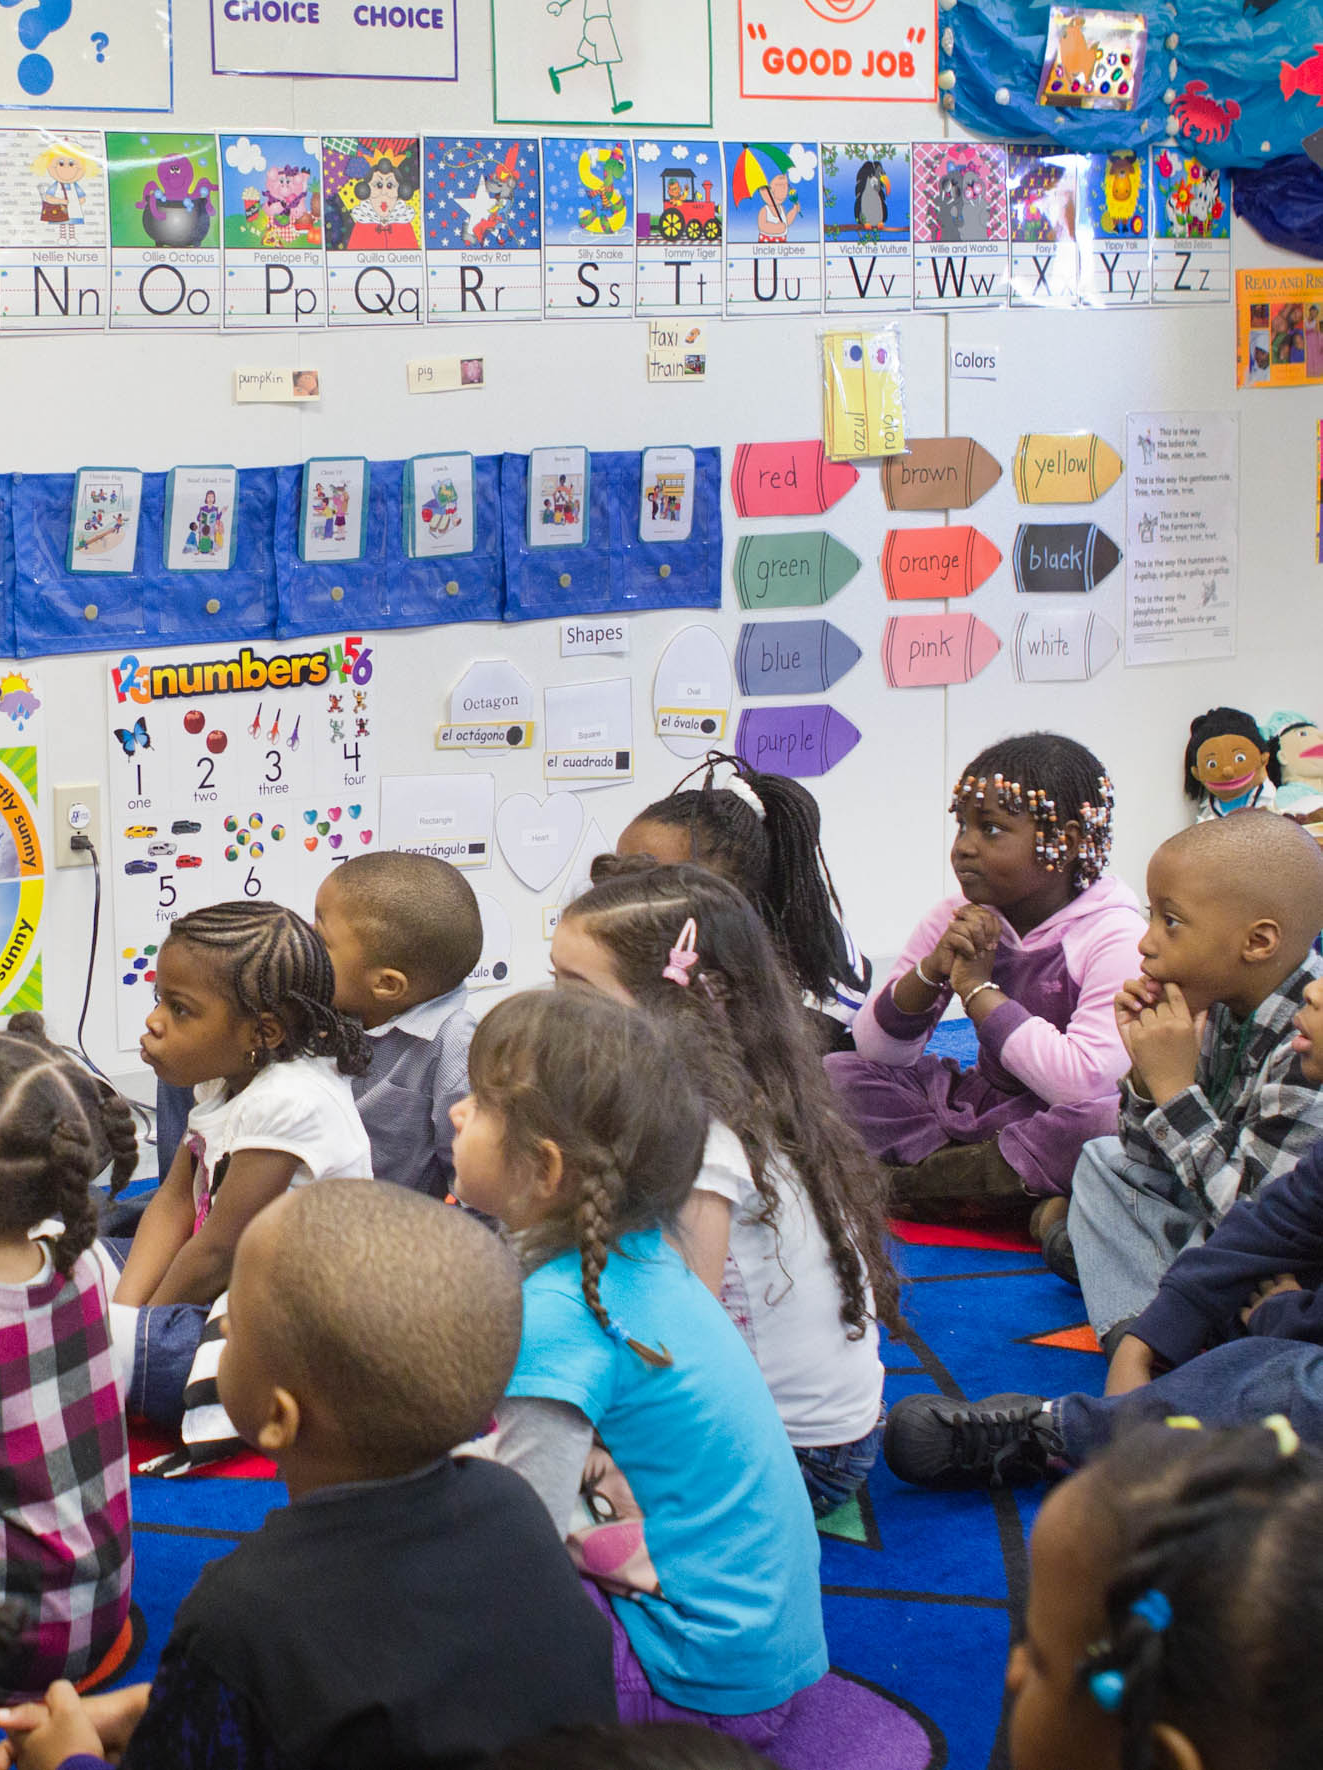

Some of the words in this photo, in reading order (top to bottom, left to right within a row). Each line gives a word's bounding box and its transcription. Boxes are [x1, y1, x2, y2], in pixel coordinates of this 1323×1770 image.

[224, 0, 319, 24] CHOICE
[353, 5, 444, 29] CHOICE
[32, 251, 64, 262] Nellie
[67, 251, 99, 262] Nurse
[142, 251, 166, 263] Ollie
[169, 251, 215, 265] Octopus
[387, 252, 422, 264] Queen
[578, 248, 594, 260] Silly
[596, 248, 624, 260] Snake
[664, 248, 694, 259] Tommy
[697, 247, 717, 259] Tiger
[752, 245, 776, 256] Uncle
[840, 244, 863, 254] Victor
[865, 243, 878, 254] the
[879, 243, 907, 254] Vulture
[952, 243, 967, 254] and
[969, 243, 998, 254] Wanda
[254, 252, 302, 266] Penelope
[304, 251, 319, 266] Pig
[461, 252, 492, 265] Rowdy
[496, 252, 511, 263] Rat
[651, 321, 679, 347] taxi
[650, 352, 684, 377] train
[954, 352, 996, 369] Colors
[417, 364, 433, 384] pig
[844, 411, 866, 452] azul
[758, 457, 798, 490] red
[900, 460, 959, 485] brown
[1035, 449, 1088, 488] yellow
[898, 553, 961, 580] orange
[1029, 546, 1083, 572] black
[756, 556, 810, 599] green
[566, 625, 624, 644] Shapes
[1027, 627, 1070, 657] white
[760, 641, 801, 673] blue
[909, 630, 955, 672] pink
[151, 647, 331, 700] numbers
[463, 694, 519, 712] Octagon
[661, 716, 672, 729] el
[673, 715, 700, 730] óvalo
[442, 729, 454, 742] el
[456, 725, 505, 745] octágono
[577, 728, 602, 741] Square
[756, 719, 816, 767] purple
[265, 750, 283, 782] 3
[343, 742, 362, 773] 4
[547, 755, 559, 769] el
[562, 754, 614, 769] cuadrado
[196, 756, 216, 789] 2
[343, 772, 366, 786] four
[194, 789, 219, 803] two
[258, 782, 290, 796] three
[128, 797, 152, 810] one
[419, 814, 454, 826] Rectangle
[12, 813, 38, 869] sunny
[531, 833, 550, 842] Heart
[158, 875, 177, 907] 5
[243, 866, 262, 897] 6
[155, 909, 179, 922] five
